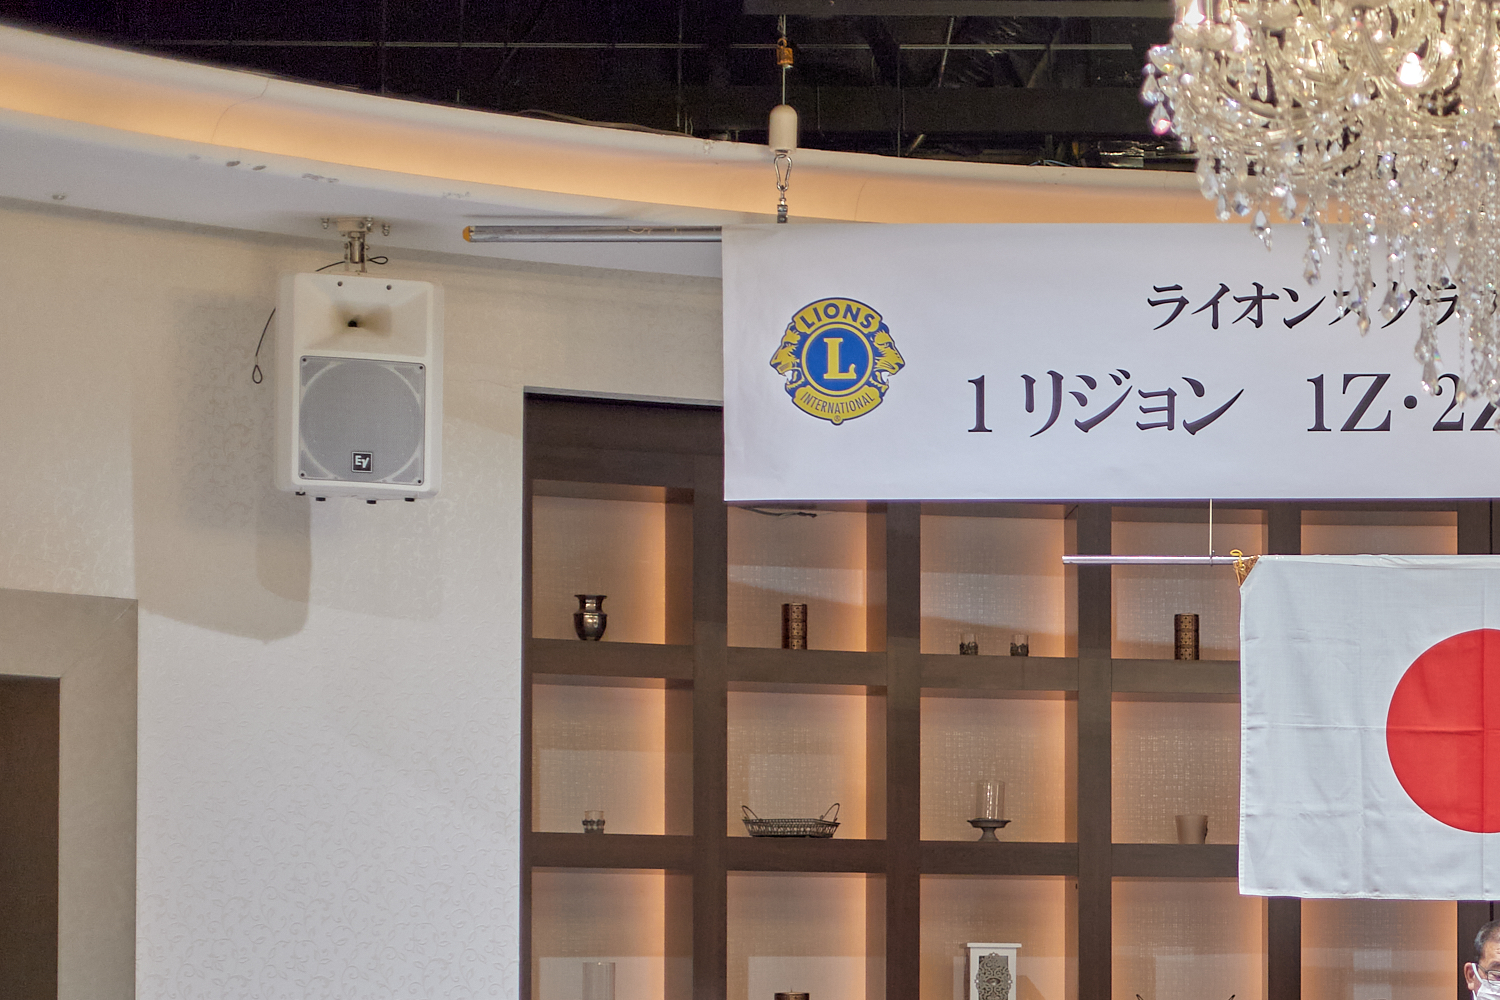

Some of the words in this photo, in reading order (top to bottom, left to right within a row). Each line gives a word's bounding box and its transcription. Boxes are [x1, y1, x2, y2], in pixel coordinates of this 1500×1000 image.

[799, 302, 876, 330] LIONS
[823, 337, 857, 380] L
[799, 391, 876, 415] INTERNATIONAL
